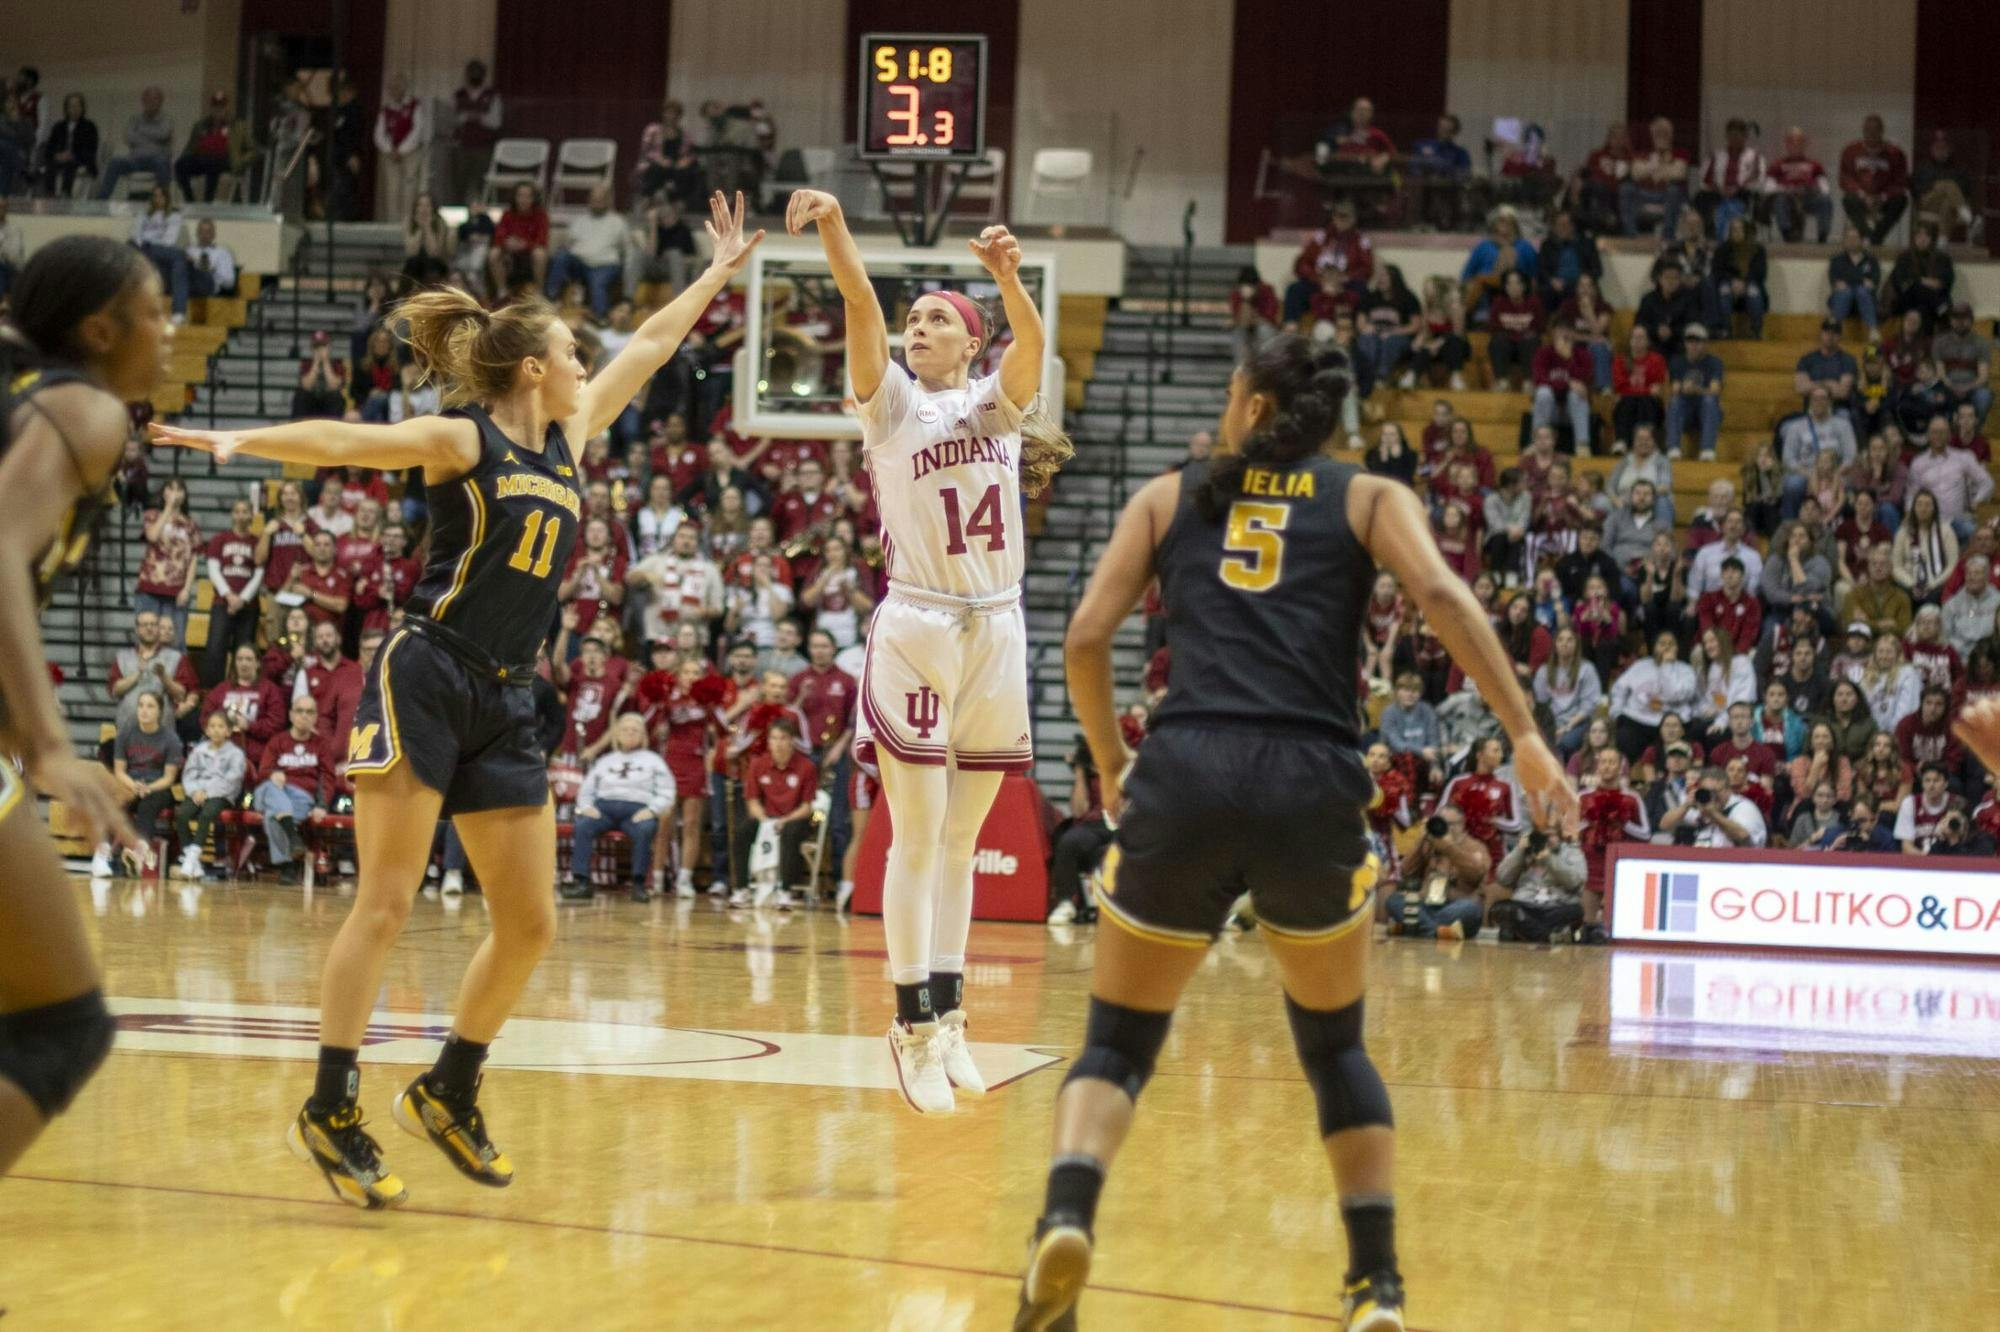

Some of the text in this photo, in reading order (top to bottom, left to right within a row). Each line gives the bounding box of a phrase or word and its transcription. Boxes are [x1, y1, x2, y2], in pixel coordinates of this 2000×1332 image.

[912, 436, 1013, 480] INDIANA
[509, 509, 560, 578] 11
[939, 483, 1005, 555] 14
[1218, 501, 1292, 592] 5
